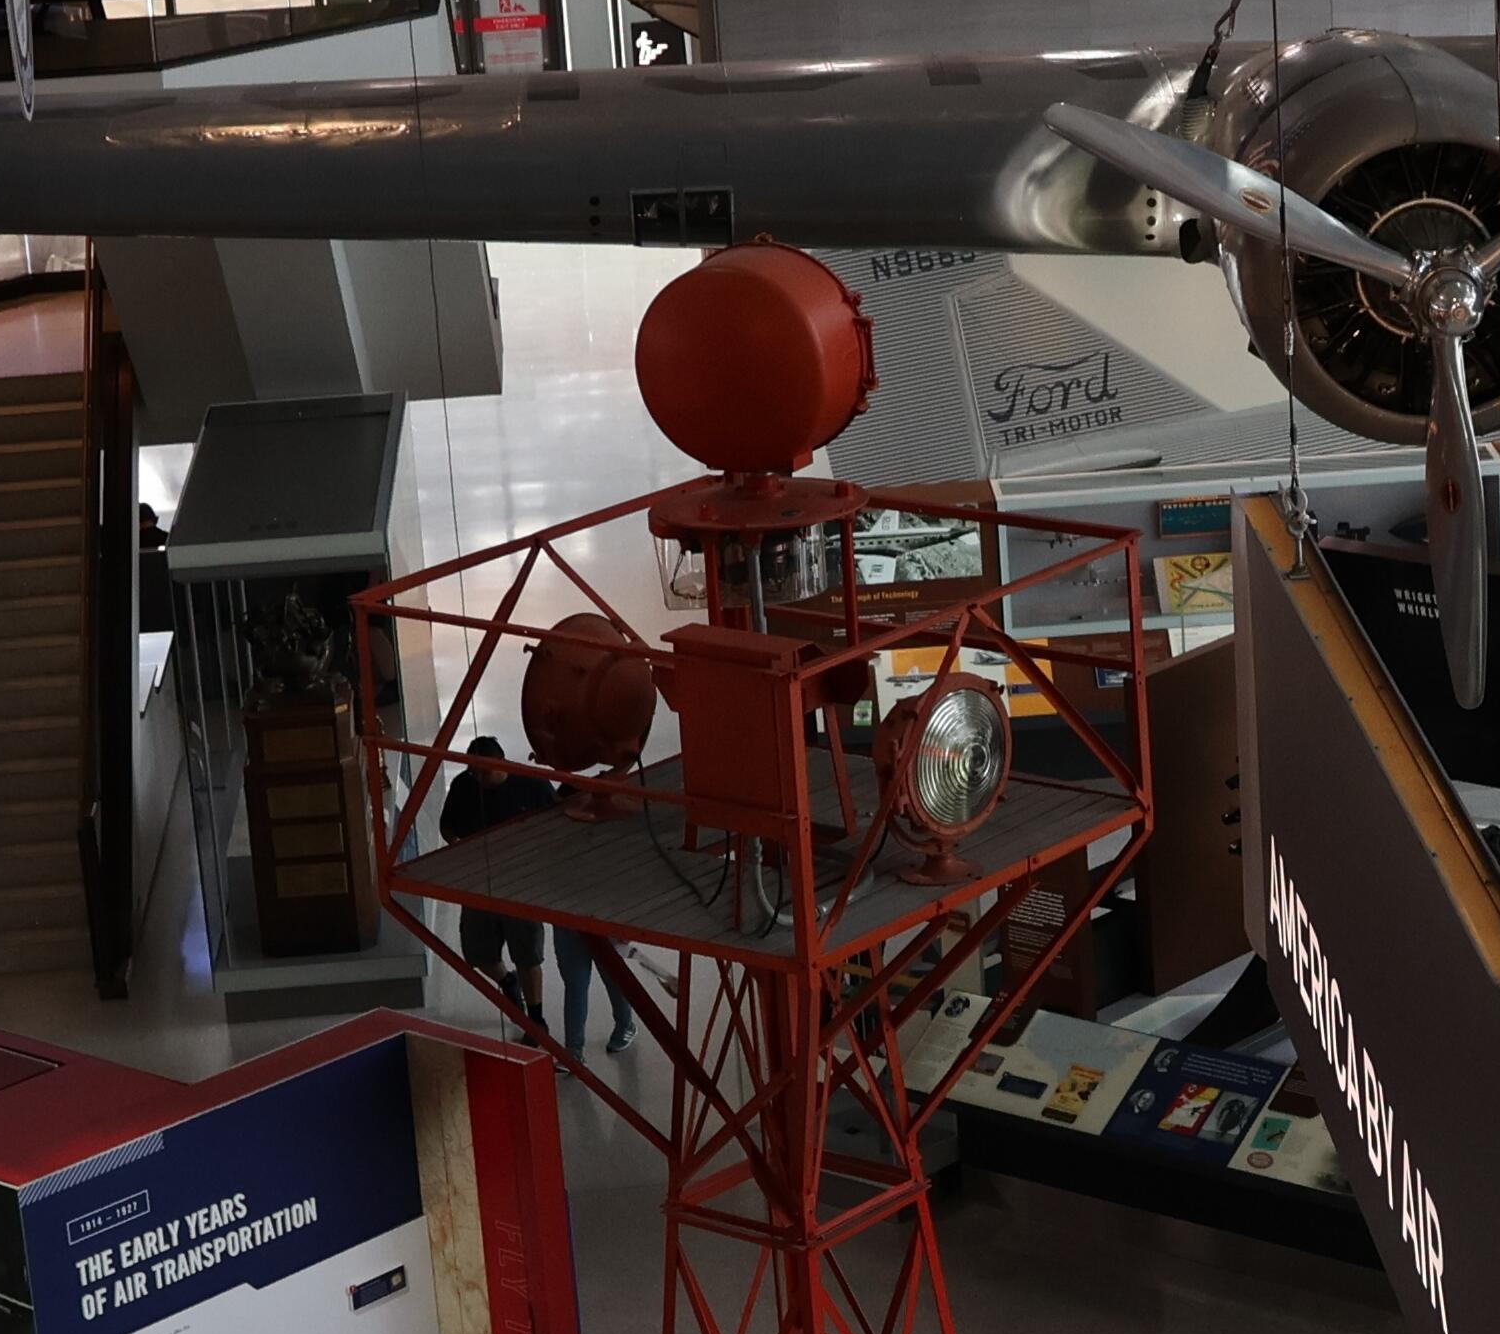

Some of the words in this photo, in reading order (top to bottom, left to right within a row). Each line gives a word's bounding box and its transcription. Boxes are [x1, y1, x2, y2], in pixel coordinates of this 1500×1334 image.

[987, 351, 1119, 423] Ford
[999, 405, 1123, 447] TRI-MOTOR
[1393, 588, 1437, 605] WRIGHT
[1269, 834, 1364, 1140] AMERICA
[1363, 1047, 1394, 1211] BY
[75, 1247, 116, 1287] THE
[118, 1219, 180, 1269] EARLY
[184, 1192, 249, 1240] YEARS
[80, 1218, 103, 1233] 1914
[115, 1201, 139, 1218] 1927
[81, 1287, 109, 1321] OF
[113, 1271, 149, 1308] AIR
[150, 1196, 319, 1291] TRANSPORTATION
[495, 1218, 527, 1300] FLY
